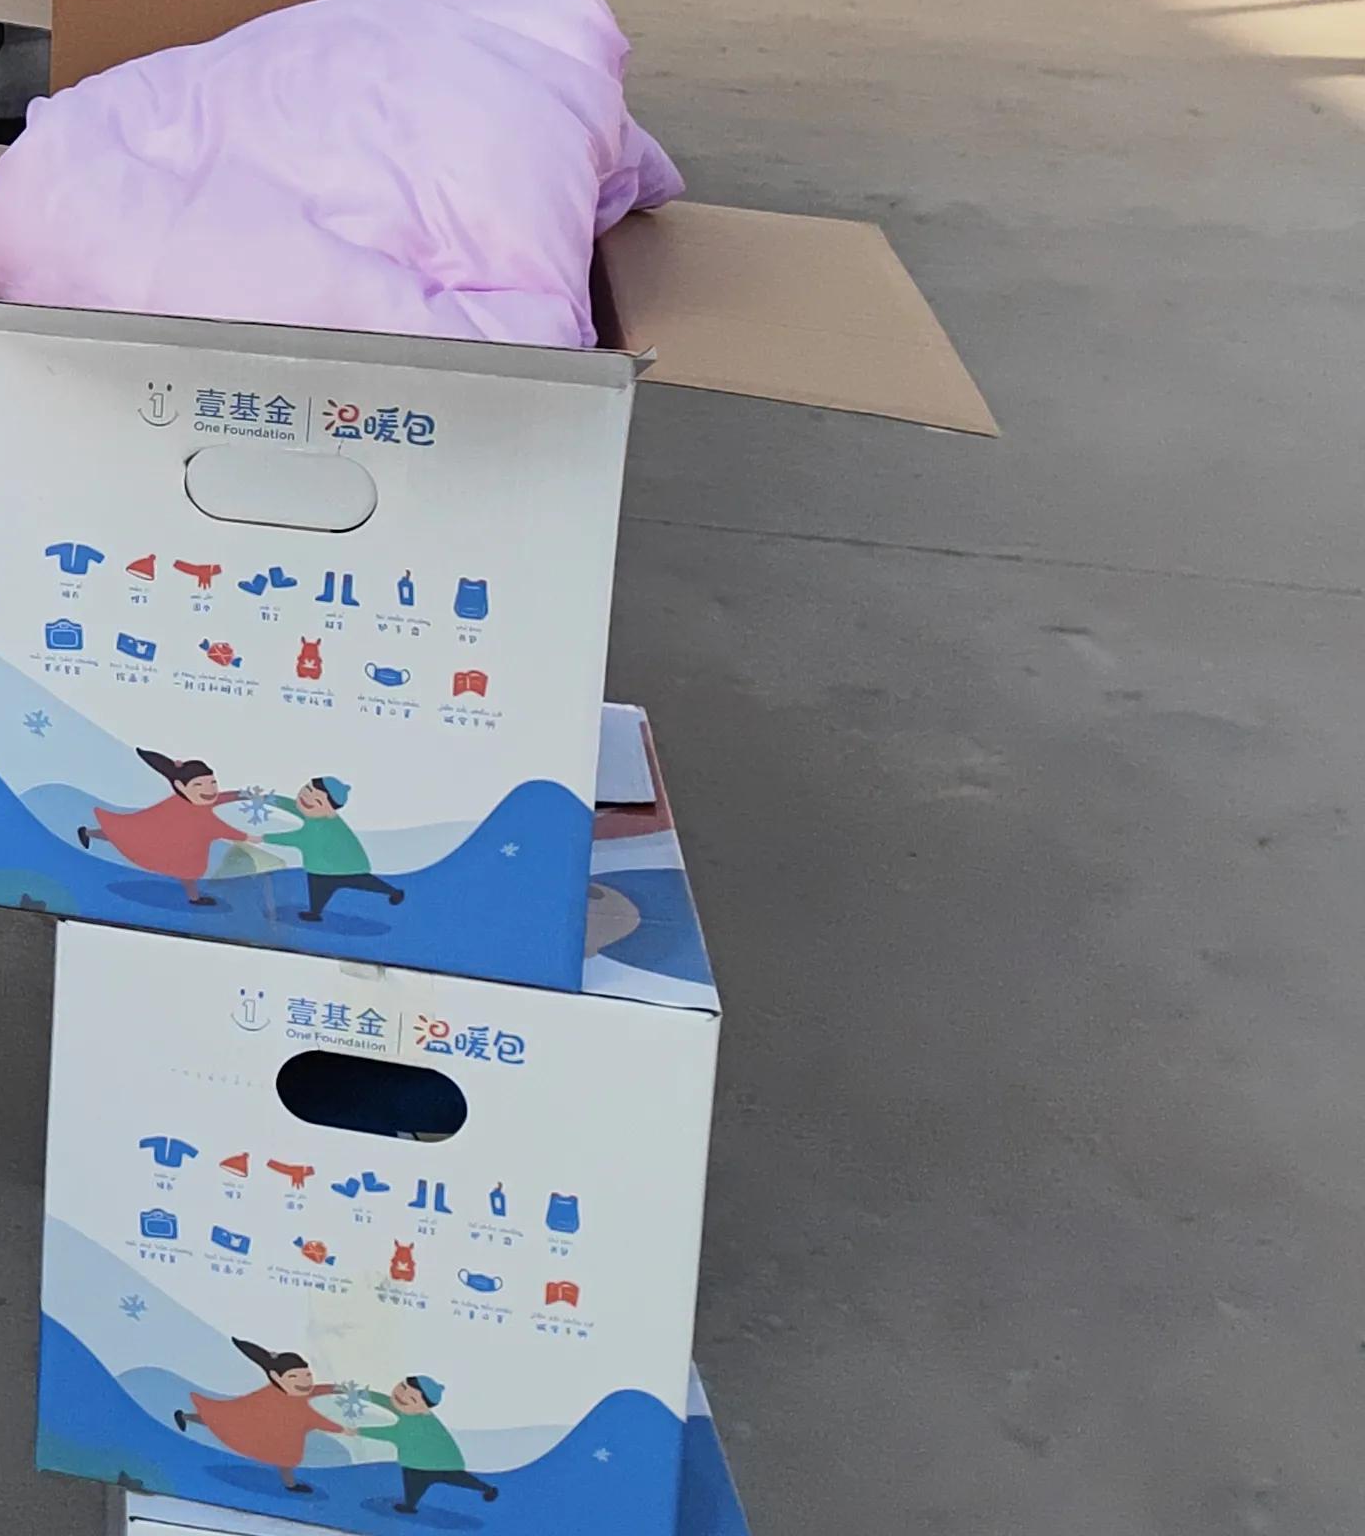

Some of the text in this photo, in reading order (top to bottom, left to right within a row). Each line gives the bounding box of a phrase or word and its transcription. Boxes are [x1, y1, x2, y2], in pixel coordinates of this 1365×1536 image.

[194, 421, 295, 441] One Foundation
[195, 388, 296, 426] 壹基金
[322, 399, 436, 446] 温暖包
[286, 998, 388, 1038] 壹基金
[413, 1015, 526, 1065] 温暖包
[286, 1029, 387, 1052] One Foundation
